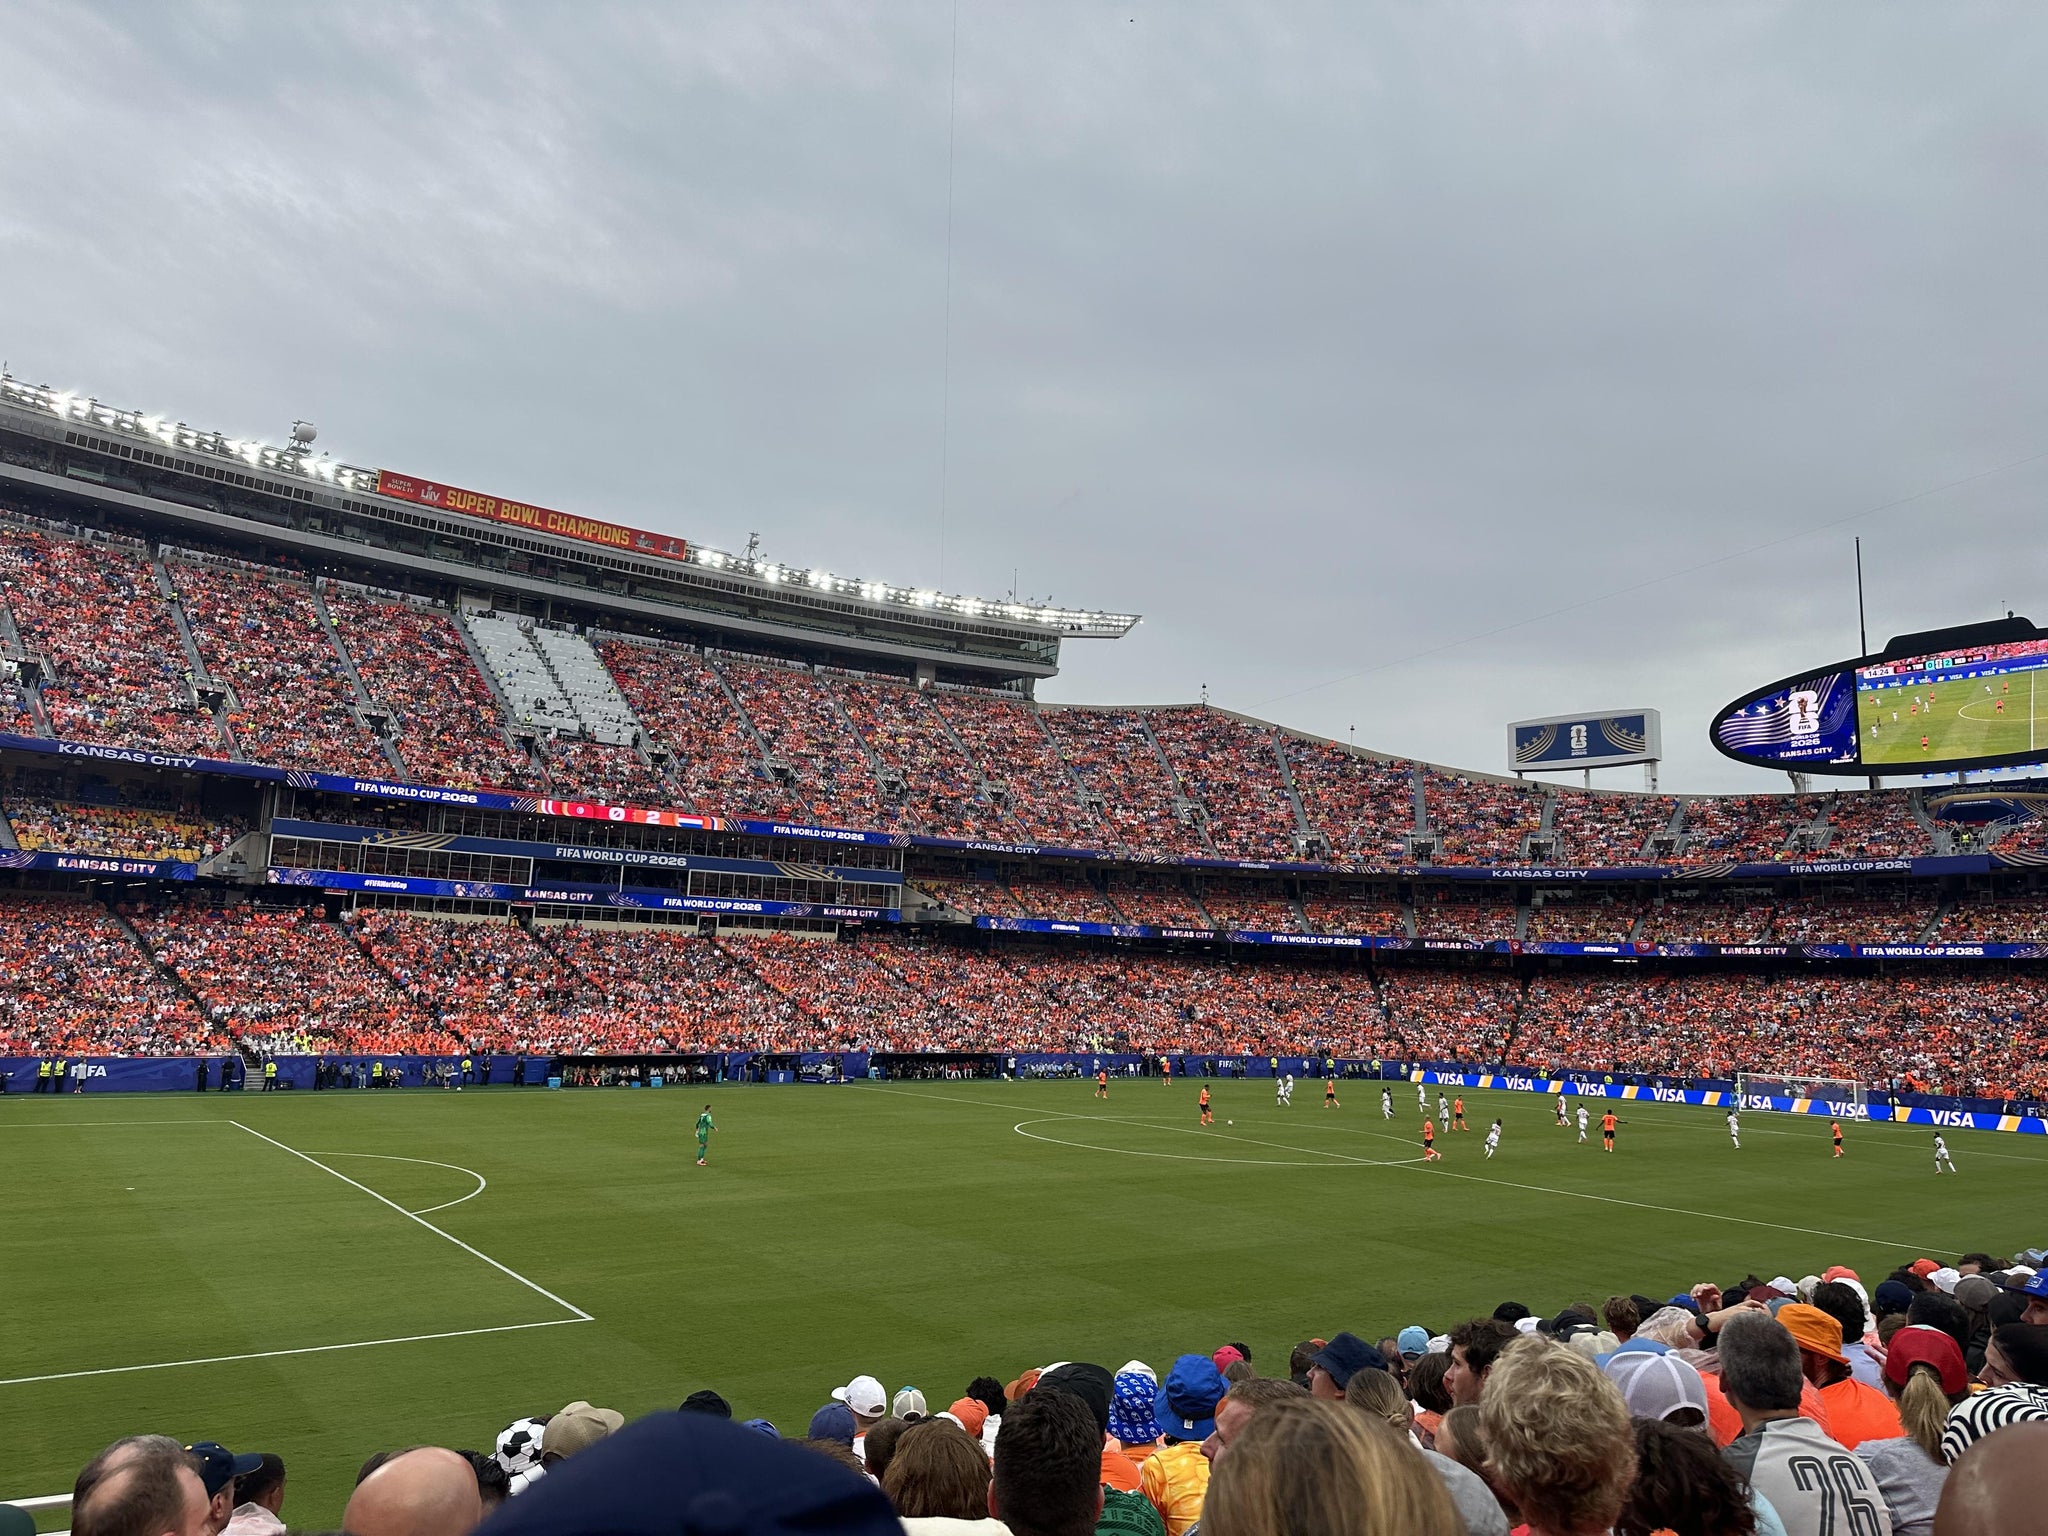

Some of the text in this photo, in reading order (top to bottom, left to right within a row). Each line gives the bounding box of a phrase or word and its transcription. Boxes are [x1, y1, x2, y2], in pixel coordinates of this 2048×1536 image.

[387, 482, 406, 492] BOWL
[392, 479, 412, 487] SUPER
[446, 490, 496, 516] SUPER
[500, 502, 542, 526] BOWL
[547, 514, 630, 546] CHAMPIONS
[1791, 739, 1820, 747] 2026
[58, 744, 196, 768] KANSAS CITY
[1780, 749, 1812, 758] KANSAS
[354, 782, 478, 804] FIFA WORLD CUP 2026
[609, 807, 625, 821] 0
[646, 811, 660, 824] 2
[773, 826, 865, 840] FIFA WORLD CUP 2026
[966, 842, 1040, 855] KANSAS CITY
[556, 847, 687, 867] FIFA WORLD CUP 2026
[58, 857, 157, 874] KANSAS CITY
[1790, 864, 1812, 873] FIFA
[1813, 863, 1851, 872] WORLD
[1852, 862, 1873, 871] CUP
[1492, 870, 1588, 878] KANSAS CITY
[525, 890, 593, 901] KANSAS CITY
[663, 898, 682, 907] FIFA
[683, 900, 714, 908] WORLD
[733, 902, 762, 911] 2026
[823, 908, 878, 918] KANSAS CITY
[1162, 930, 1194, 938] KANSAS
[1272, 935, 1288, 943] FIFA
[1720, 947, 1787, 955] KANSAS CITY
[1862, 947, 1984, 955] FIFA WORLD CUP 2026
[71, 1066, 107, 1076] FFA
[1434, 1072, 1464, 1086] VISA
[1503, 1077, 1534, 1091] VISA
[1573, 1082, 1606, 1097] VISA
[1650, 1087, 1686, 1103] VISA
[1826, 1101, 1868, 1117] VISA
[1927, 1109, 1975, 1128] VISA
